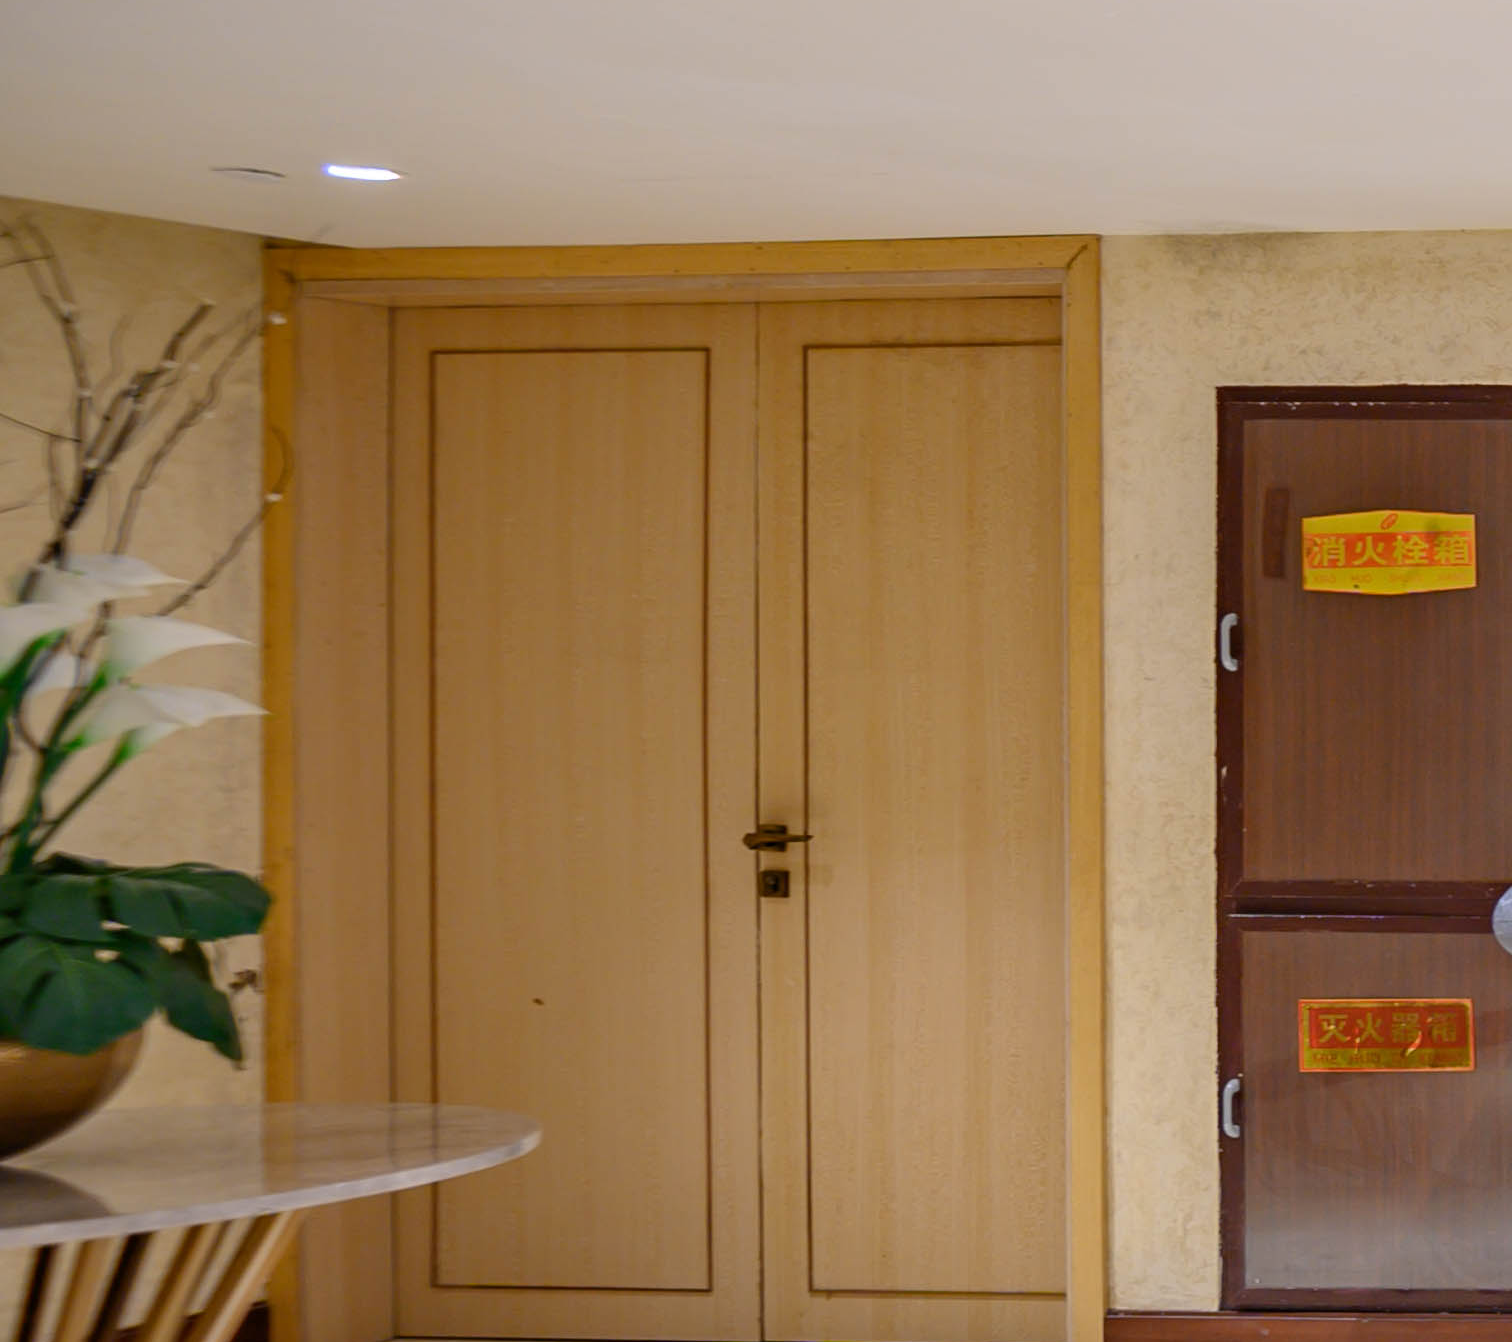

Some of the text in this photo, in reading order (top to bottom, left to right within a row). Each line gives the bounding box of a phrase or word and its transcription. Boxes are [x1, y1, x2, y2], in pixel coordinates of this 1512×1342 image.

[1311, 535, 1469, 566] 消火栓箱
[1318, 1012, 1457, 1043] 灭火器箱
